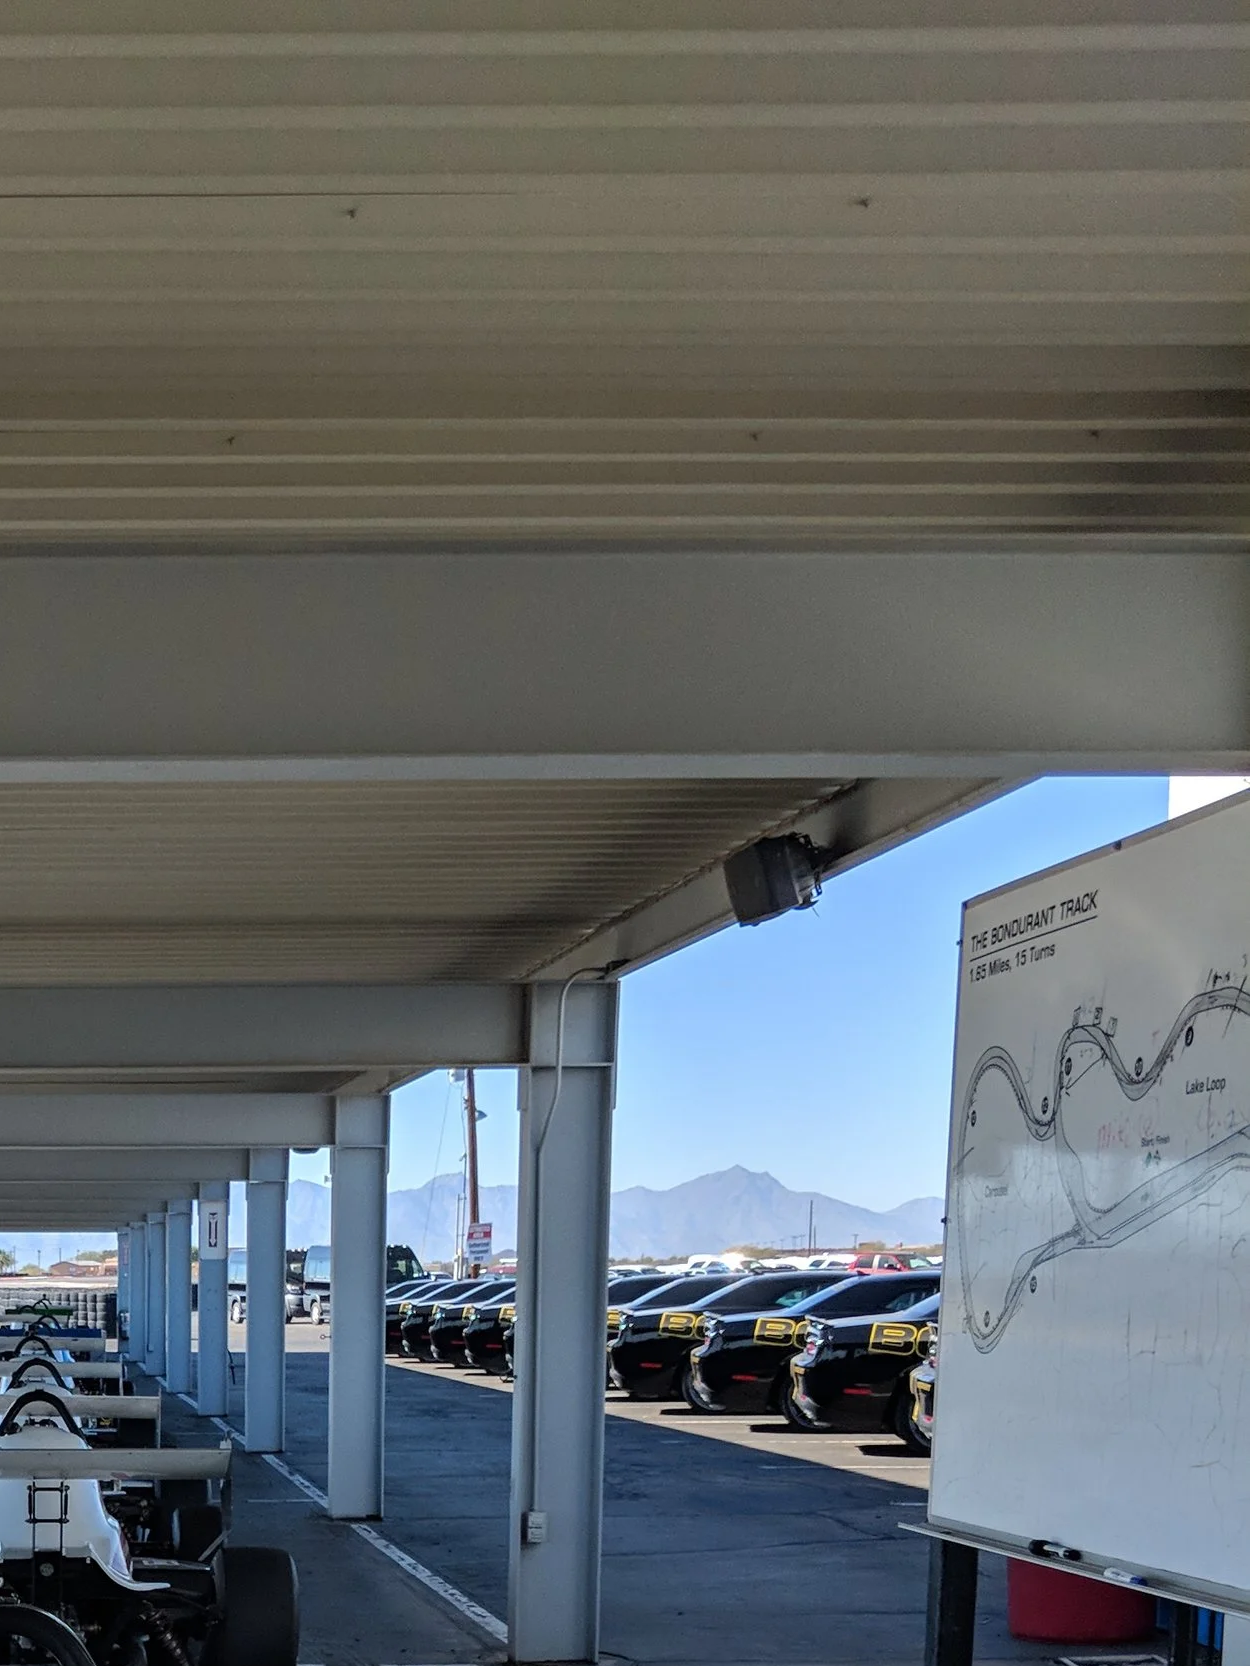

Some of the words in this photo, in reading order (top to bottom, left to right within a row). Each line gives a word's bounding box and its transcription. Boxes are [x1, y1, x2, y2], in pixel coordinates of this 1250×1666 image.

[971, 931, 988, 952] THE
[991, 905, 1056, 945] BONDURANT
[1060, 889, 1099, 920] TRACK
[1015, 949, 1027, 967] 15
[1030, 944, 1056, 962] Turns
[1185, 1080, 1205, 1095] Lake
[1206, 1077, 1226, 1094] Loop
